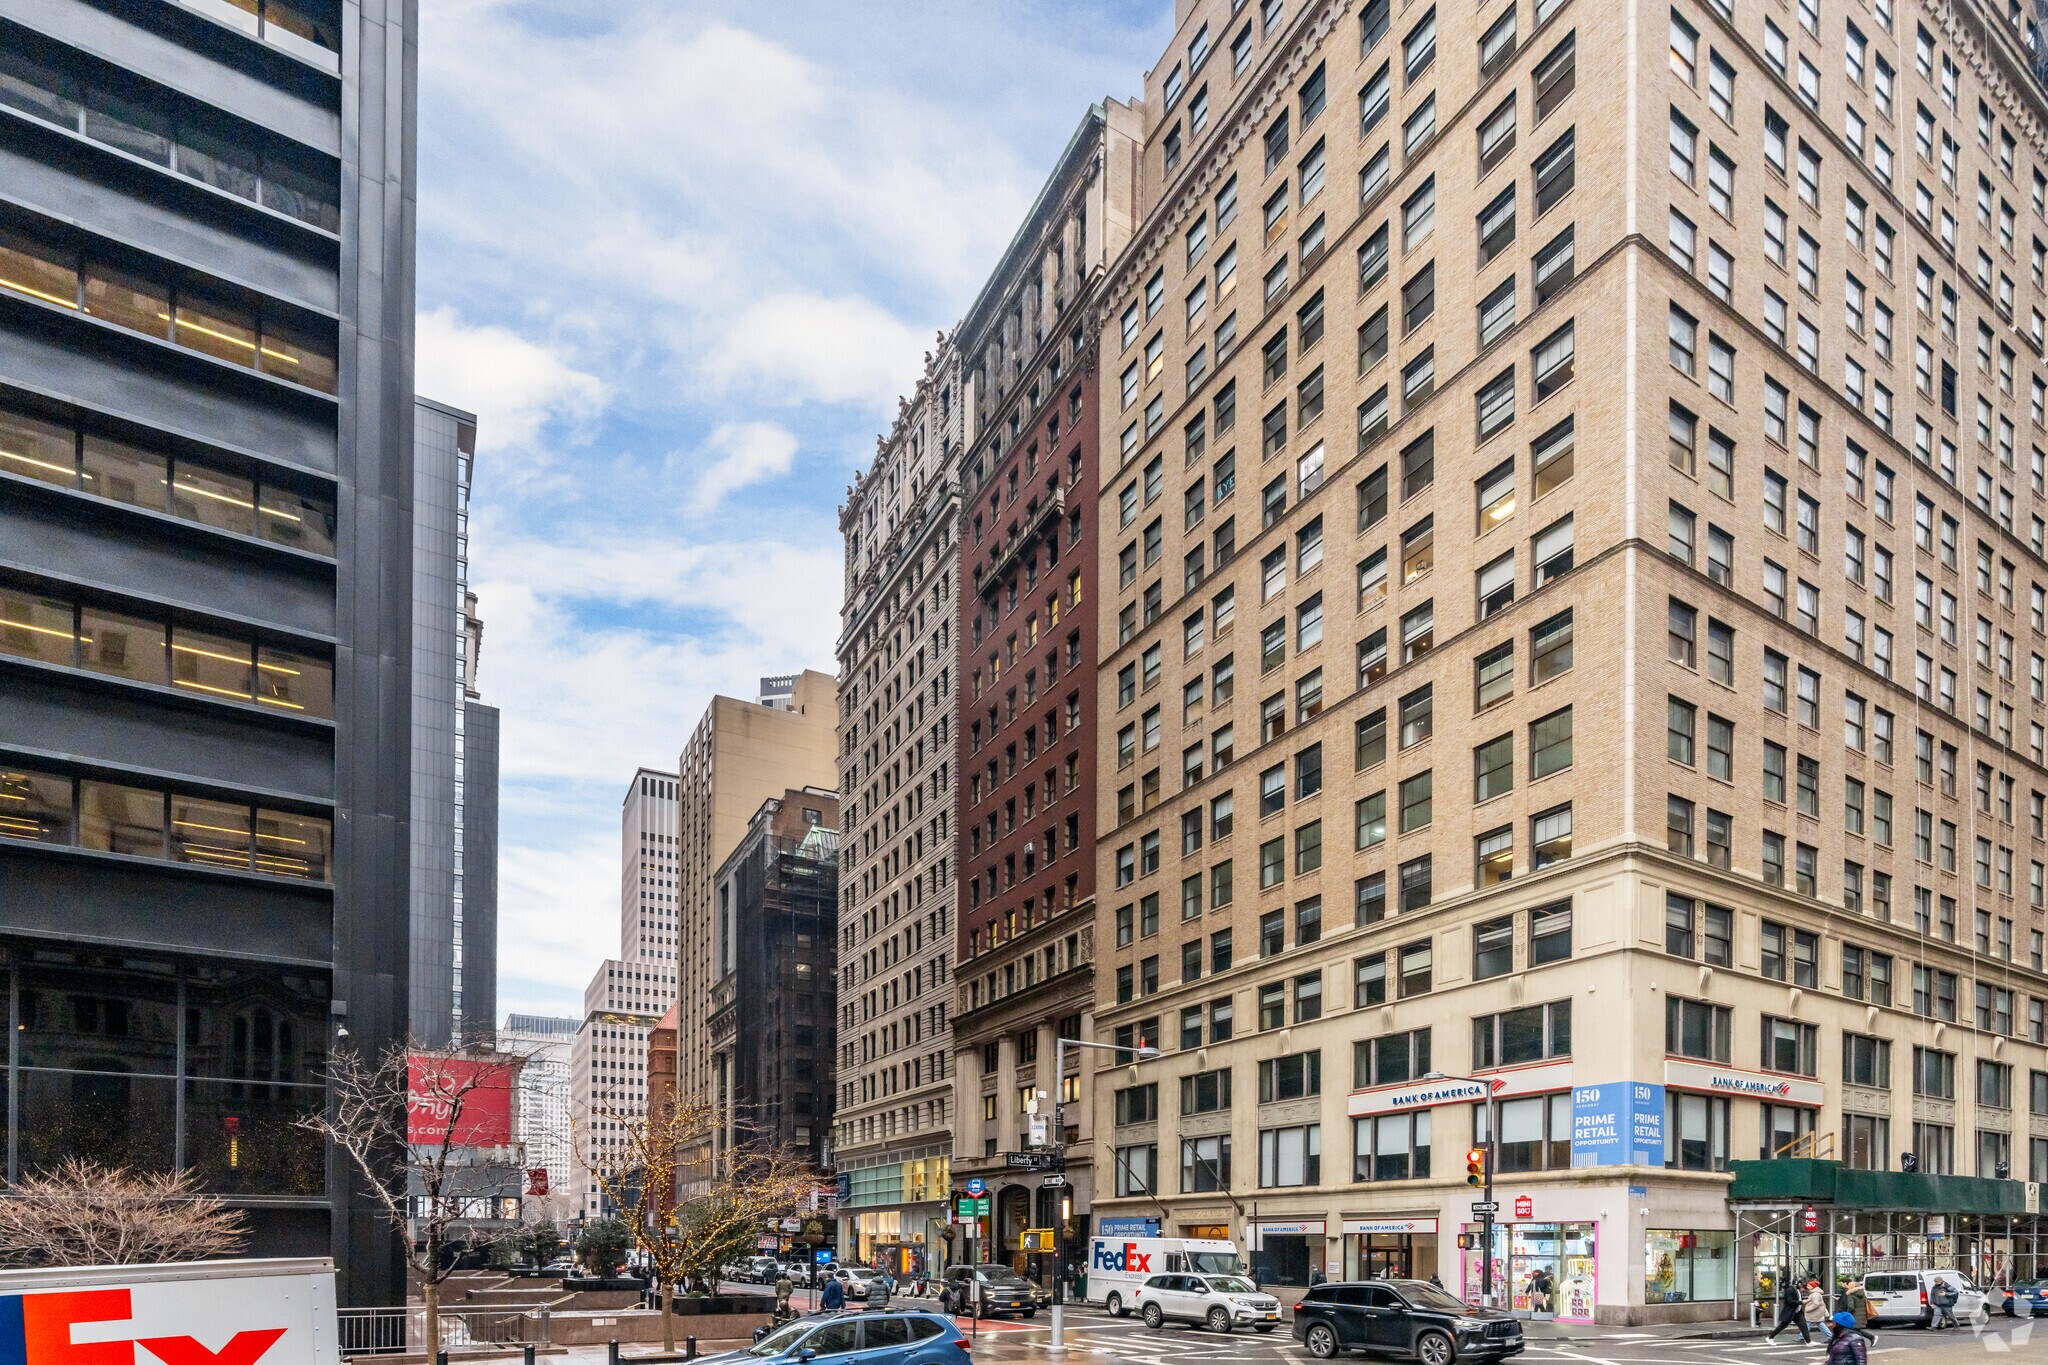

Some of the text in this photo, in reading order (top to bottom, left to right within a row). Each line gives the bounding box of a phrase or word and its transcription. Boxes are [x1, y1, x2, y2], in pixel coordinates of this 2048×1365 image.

[1713, 1076, 1776, 1093] BANK OF AMERICA
[1392, 1085, 1483, 1106] BANK OF AMERICA
[1575, 1089, 1600, 1104] 150
[1634, 1086, 1651, 1101] 150
[1575, 1114, 1616, 1127] PRIME
[1634, 1113, 1660, 1125] PRIME
[1575, 1126, 1617, 1139] RETAIL
[1634, 1125, 1661, 1138] RETAIL
[1574, 1137, 1620, 1147] OPPORTUNITY
[1633, 1137, 1663, 1146] OPPORTUNITY
[1010, 1155, 1033, 1166] Liberty
[1805, 1211, 1817, 1219] MINI
[1101, 1222, 1146, 1236] 150 PRIME RETAIL
[1093, 1241, 1152, 1273] FedEx
